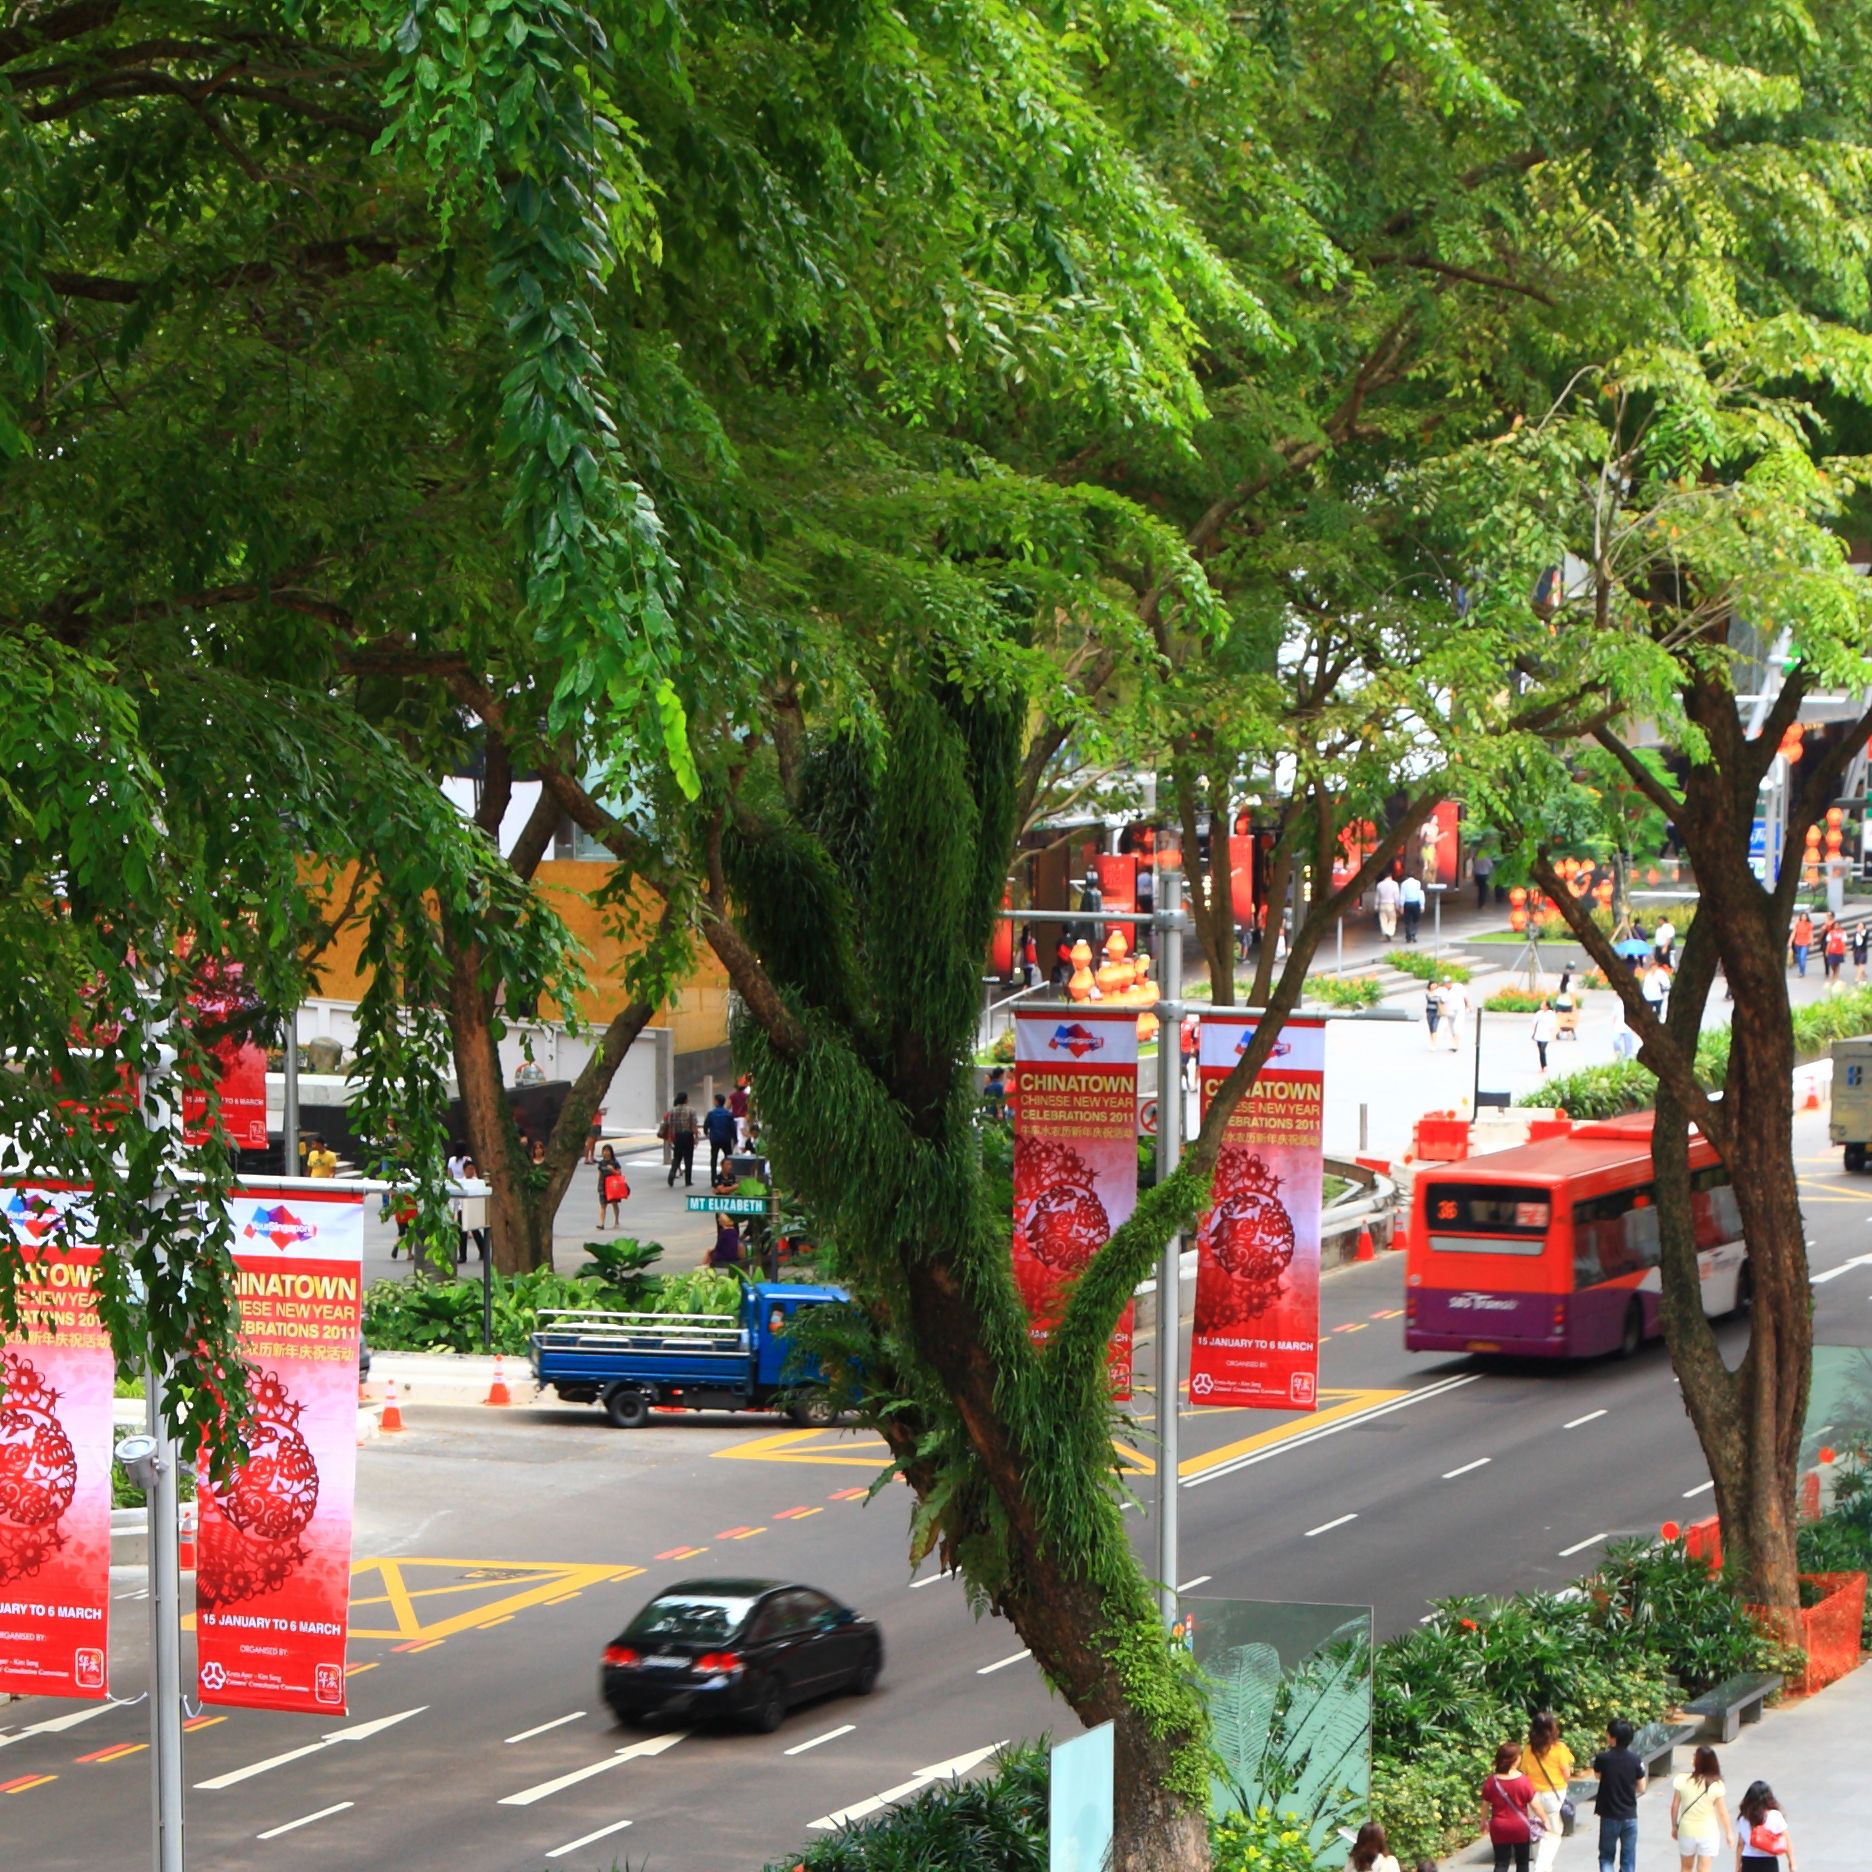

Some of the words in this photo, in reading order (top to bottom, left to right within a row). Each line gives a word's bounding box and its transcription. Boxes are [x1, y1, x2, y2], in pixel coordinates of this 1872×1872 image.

[1020, 1072, 1134, 1093] CHINATOWN
[1205, 1079, 1321, 1101] CATOWN
[1020, 1094, 1071, 1107] CHINESE
[1073, 1096, 1101, 1108] NEW
[1101, 1096, 1133, 1108] YEAR
[1021, 1109, 1107, 1122] CELEBRATIONS
[1109, 1111, 1134, 1122] 2011
[1259, 1102, 1286, 1114] NEW
[1288, 1103, 1320, 1116] YEAR
[1229, 1115, 1293, 1129] EBRATIONS
[1295, 1119, 1321, 1130] 2011
[690, 1197, 705, 1209] MT
[708, 1198, 763, 1212] ELIZABETH
[275, 1301, 311, 1319] NEW
[312, 1304, 355, 1321] YEAR
[323, 1325, 356, 1340] 2011
[1198, 1336, 1208, 1346] 15
[1209, 1337, 1253, 1348] JANUARY
[1255, 1339, 1268, 1349] TO
[1277, 1341, 1314, 1351] MARCH
[29, 1603, 46, 1616] TO
[48, 1605, 56, 1617] 6
[58, 1606, 103, 1620] MARCH
[203, 1613, 216, 1626] 15
[219, 1614, 271, 1629] JANUARY
[272, 1618, 288, 1631] TO
[289, 1620, 297, 1632] 6
[299, 1621, 341, 1636] MARCH
[240, 1644, 278, 1656] ORGANISED
